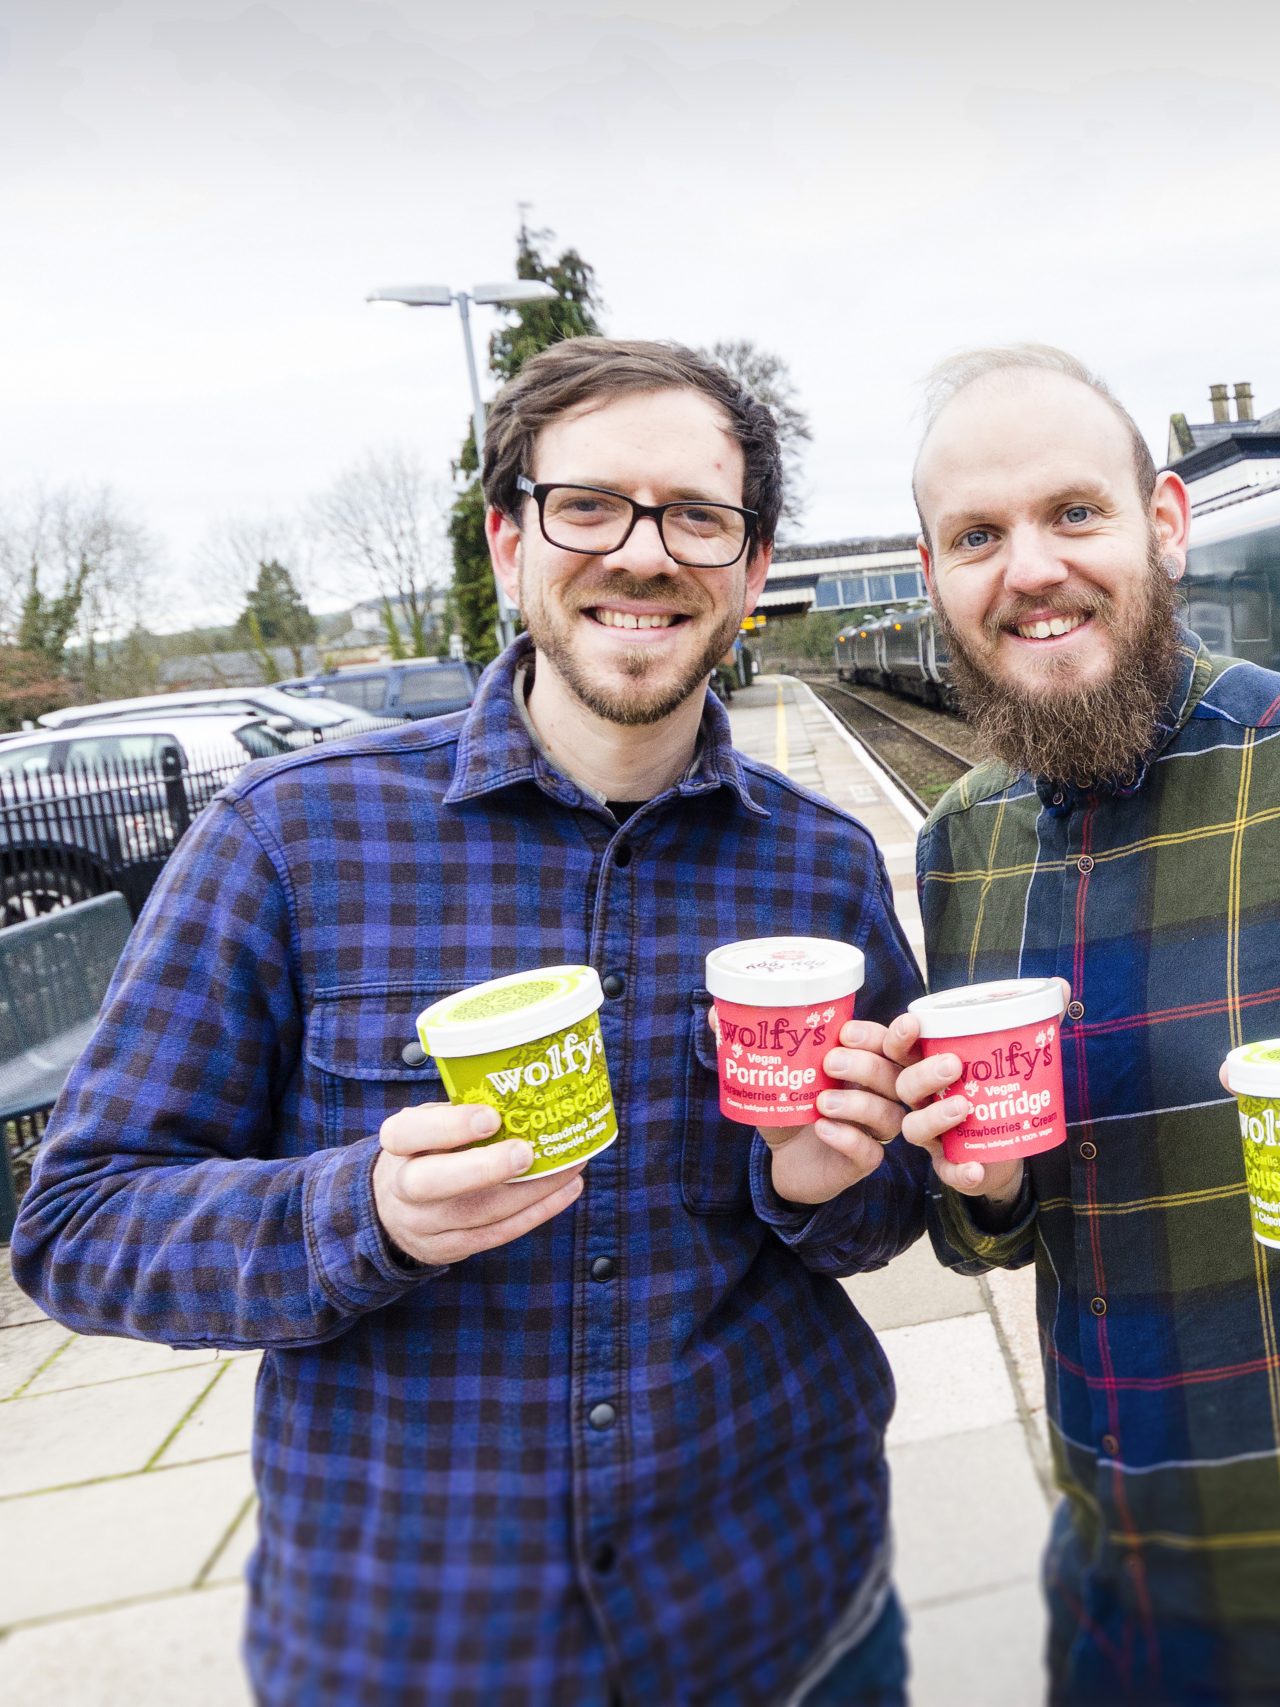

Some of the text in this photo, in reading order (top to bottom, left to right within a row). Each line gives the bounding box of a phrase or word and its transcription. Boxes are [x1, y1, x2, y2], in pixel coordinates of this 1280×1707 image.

[720, 1018, 826, 1057] wolfys
[747, 1052, 781, 1066] Vegan
[725, 1057, 816, 1090] Porridge
[534, 1085, 570, 1105] Garlic
[722, 1080, 777, 1101] Strawberries
[779, 1093, 788, 1102] &
[984, 1082, 1020, 1097] Vegan
[505, 1074, 610, 1133] Couscous
[538, 1118, 588, 1145] Sundried
[956, 1122, 1021, 1138] Strawberries
[1023, 1120, 1031, 1130] &
[543, 1135, 584, 1156] Chipotle
[1253, 1152, 1279, 1167] Garlic
